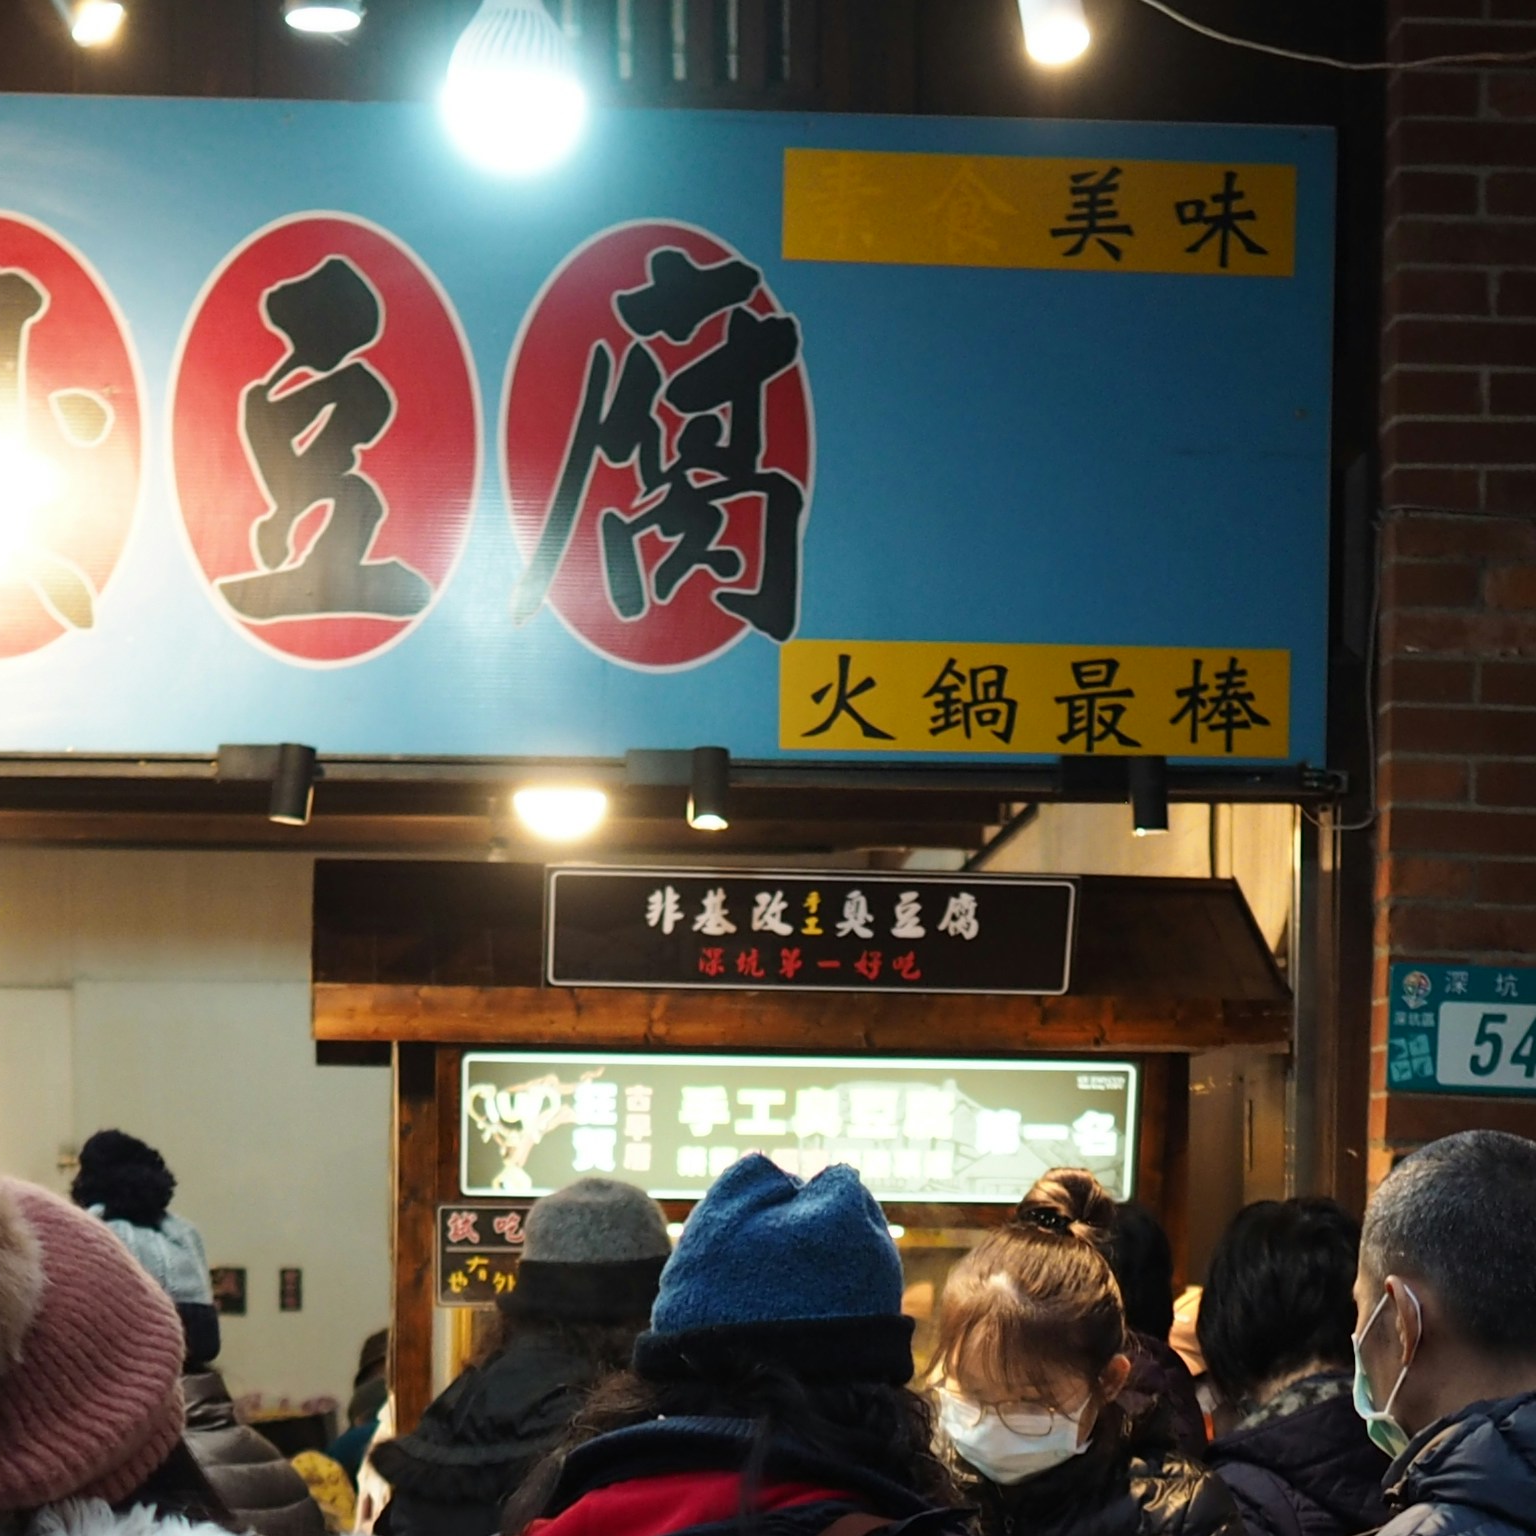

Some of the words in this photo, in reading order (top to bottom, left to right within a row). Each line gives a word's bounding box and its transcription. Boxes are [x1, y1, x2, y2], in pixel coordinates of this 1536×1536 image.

[801, 653, 1270, 755] 火鍋最棒
[698, 947, 922, 980] 深坑第一好吃
